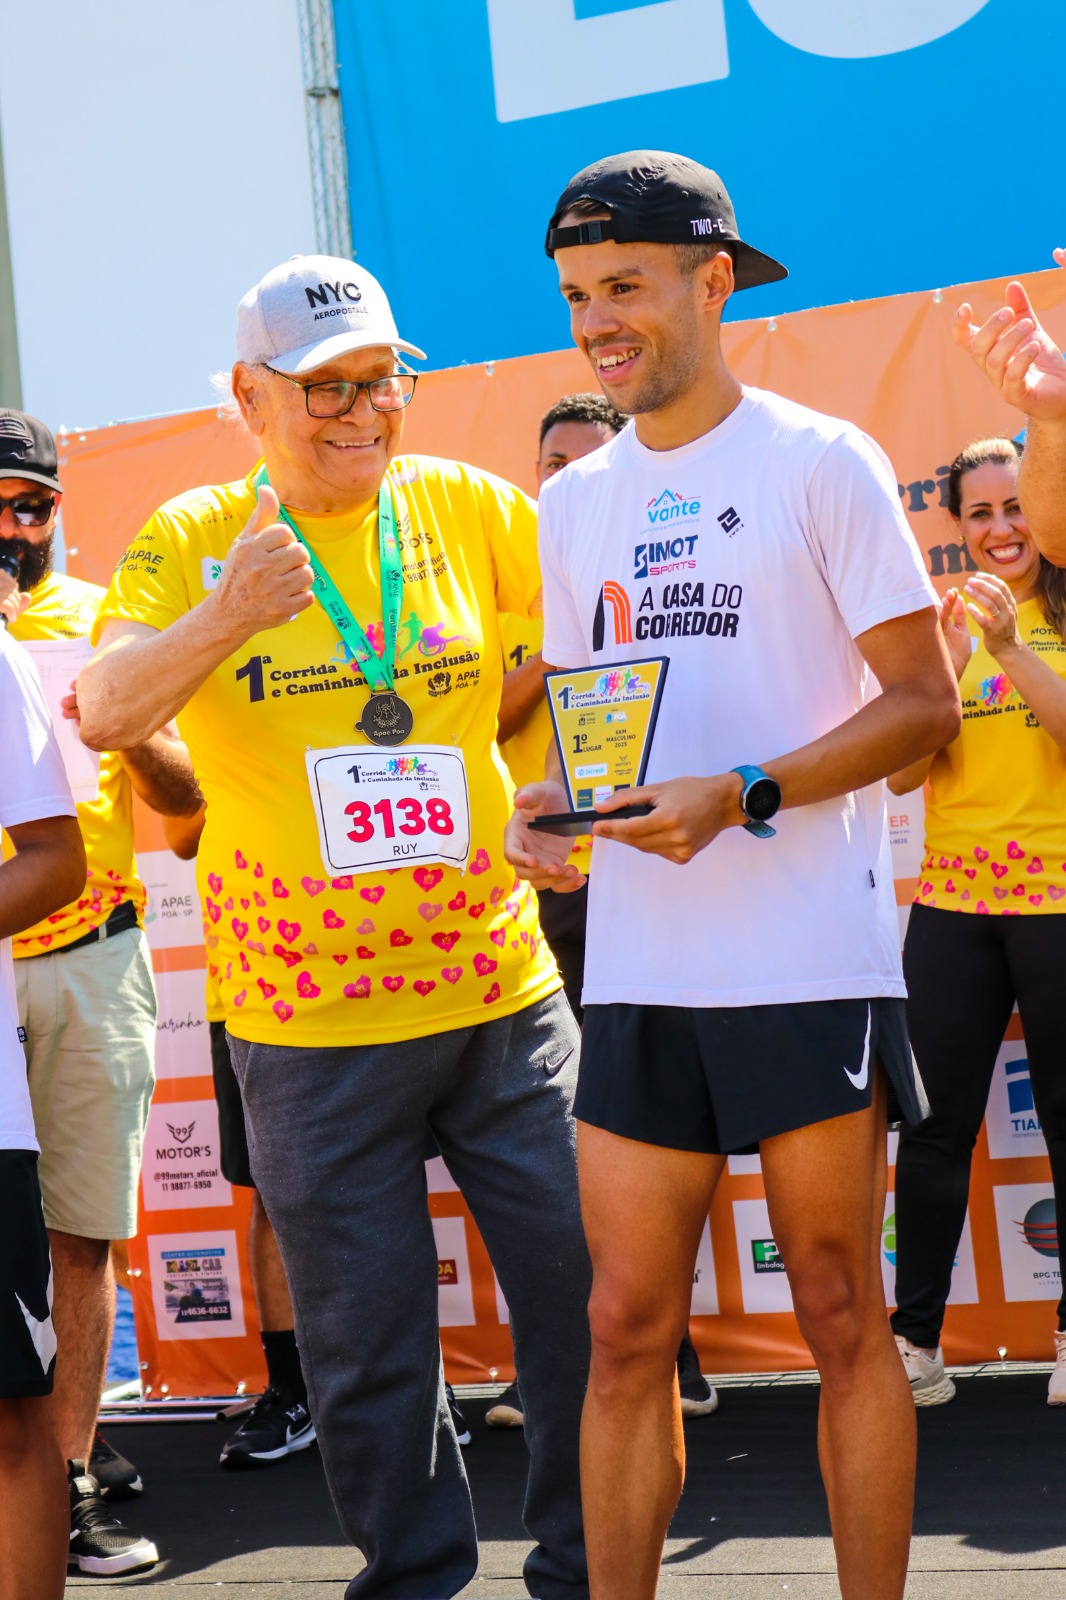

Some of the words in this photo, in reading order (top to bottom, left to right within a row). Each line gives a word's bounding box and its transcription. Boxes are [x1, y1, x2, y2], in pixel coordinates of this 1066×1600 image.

[690, 218, 726, 236] TWO-E
[305, 281, 362, 309] NYC
[314, 306, 369, 321] AEROPOSTALE
[648, 501, 701, 524] vante
[649, 560, 697, 576] SPORTS
[638, 586, 654, 612] A
[662, 582, 704, 609] CASA
[711, 583, 743, 609] DO
[270, 664, 338, 682] Corrida
[272, 689, 282, 698] e
[286, 676, 369, 696] Caminha
[413, 650, 480, 675] Inclusão
[456, 669, 481, 683] APAE
[571, 692, 596, 700] Corrida
[576, 698, 612, 708] Caminhada
[622, 692, 650, 702] Inclusão
[606, 734, 636, 743] MASCULINO
[583, 744, 602, 753] LUGAR
[344, 797, 455, 843] 3138
[393, 843, 418, 856] RUY
[161, 895, 192, 909] APAE
[157, 1011, 205, 1033] arinho
[175, 1127, 188, 1136] 99
[156, 1145, 212, 1160] MOTOR'S
